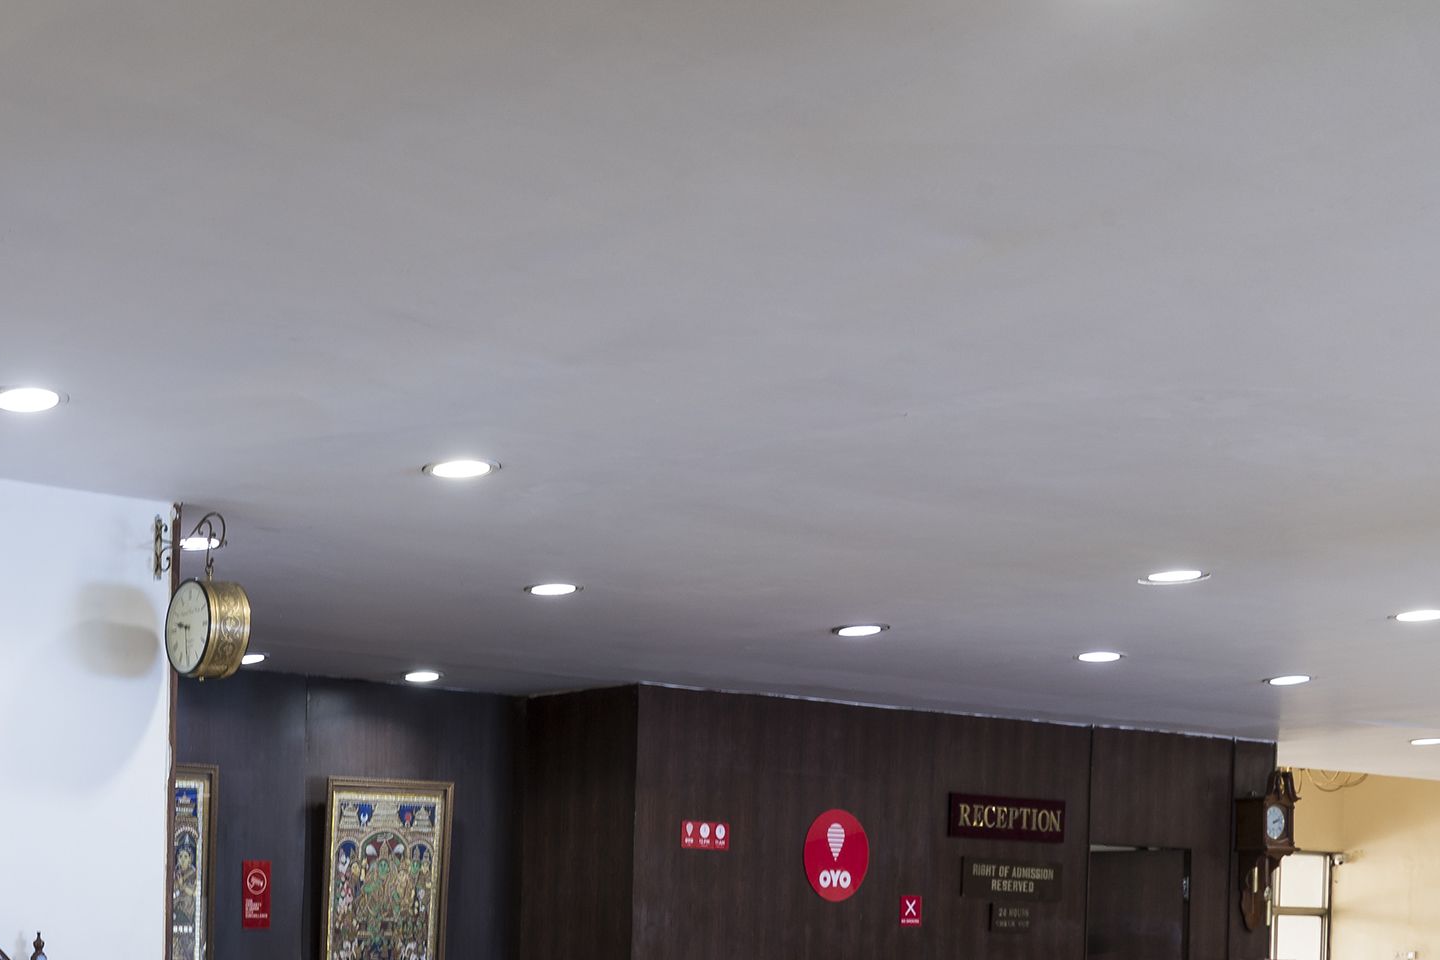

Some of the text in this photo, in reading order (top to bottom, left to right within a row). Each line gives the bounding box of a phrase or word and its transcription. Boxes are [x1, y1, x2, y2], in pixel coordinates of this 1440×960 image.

[958, 803, 1062, 832] RECEPTION
[819, 869, 851, 888] OYO
[972, 863, 1055, 881] RIGHT OF ADMISSION
[991, 879, 1034, 893] RESERVED
